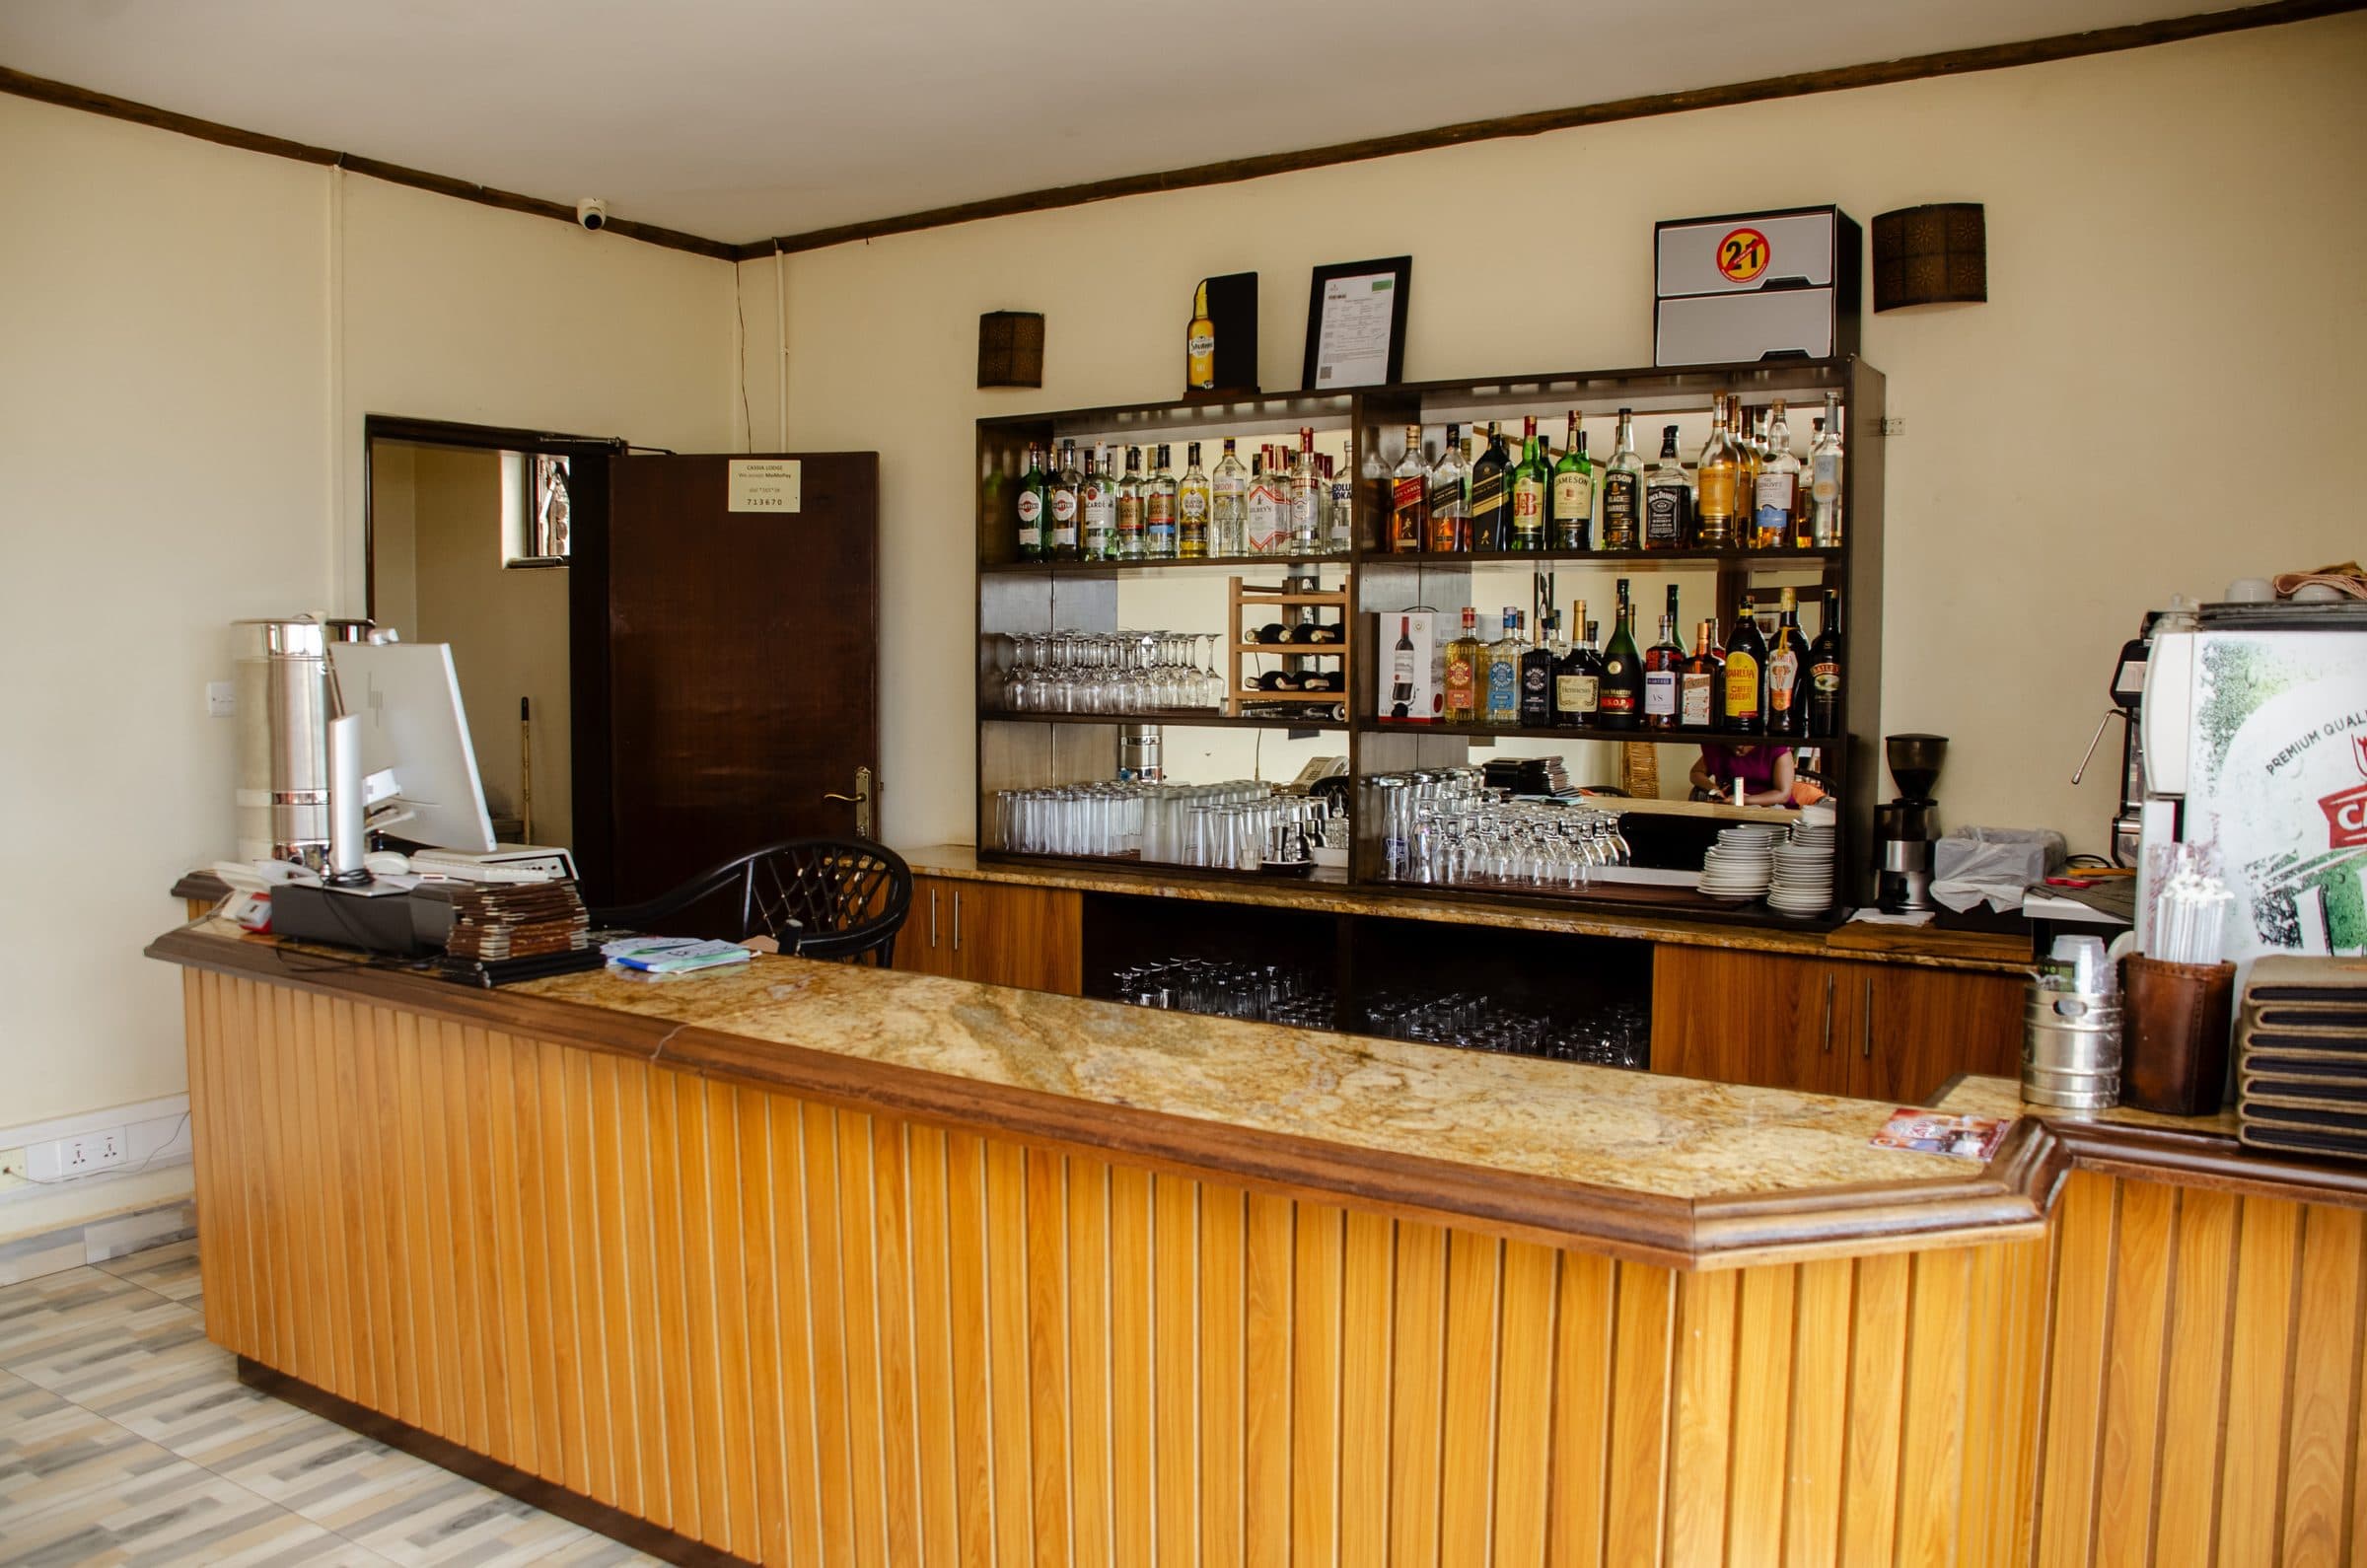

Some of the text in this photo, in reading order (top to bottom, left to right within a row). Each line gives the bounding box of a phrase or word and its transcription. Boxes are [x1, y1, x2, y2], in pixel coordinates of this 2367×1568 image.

[1556, 475, 1589, 487] JAMESON
[1607, 472, 1633, 484] MESON
[2265, 730, 2321, 776] PREMIUM
